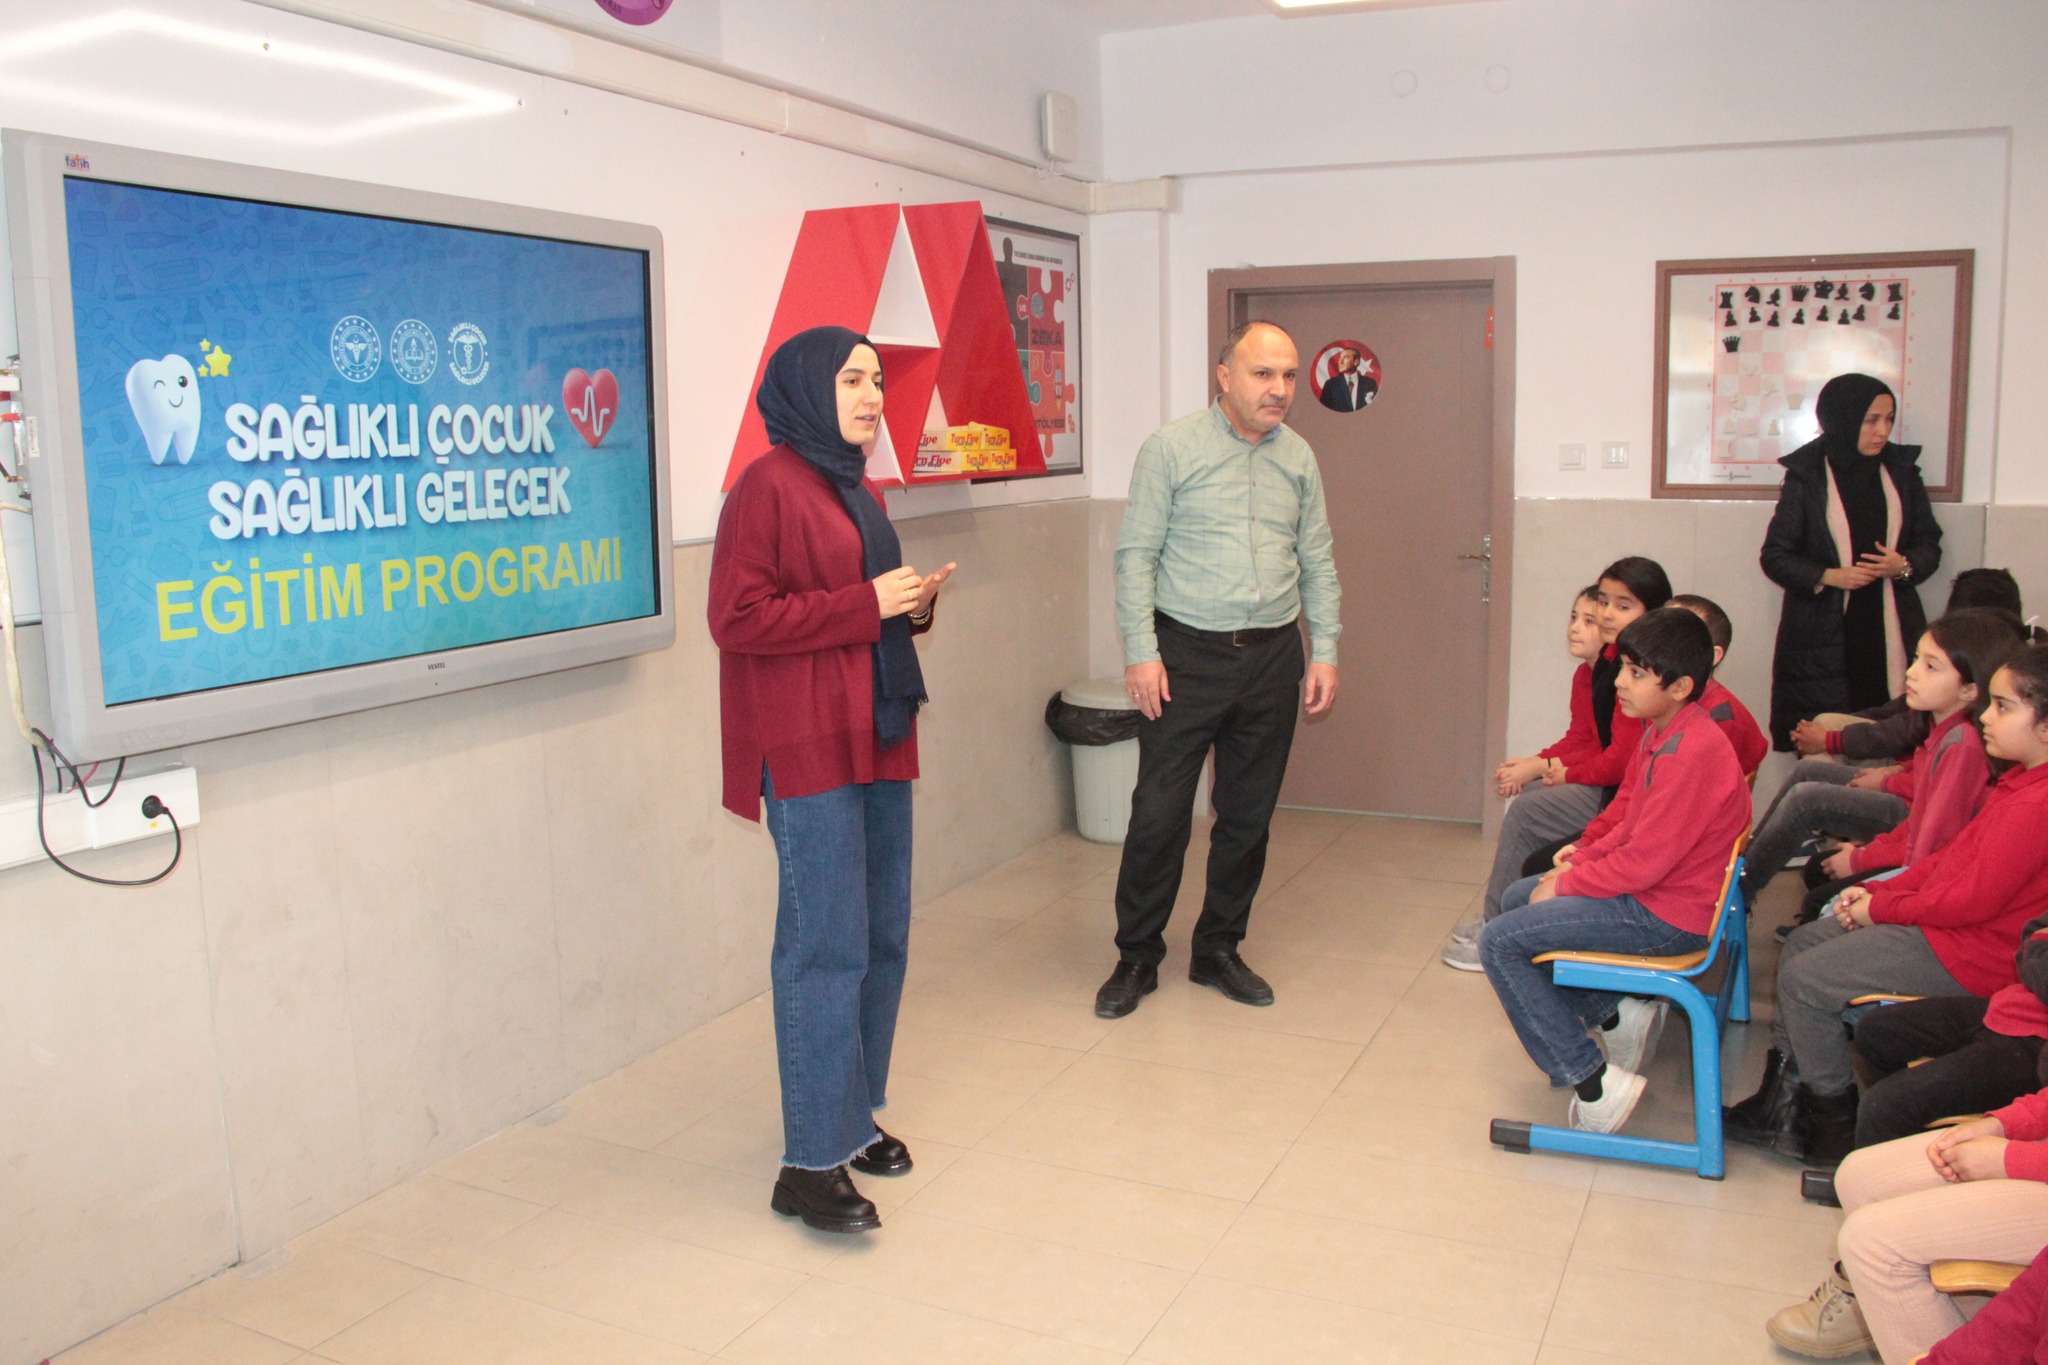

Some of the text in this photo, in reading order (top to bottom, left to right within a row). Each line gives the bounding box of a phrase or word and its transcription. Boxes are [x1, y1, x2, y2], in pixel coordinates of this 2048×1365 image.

[225, 394, 556, 465] SAĞLIKLI ÇOCUK
[208, 466, 572, 540] SAĞLIKLI GELECEK
[156, 536, 622, 642] EĞİTİM PROGRAMI
[427, 662, 446, 670] VESTEL
